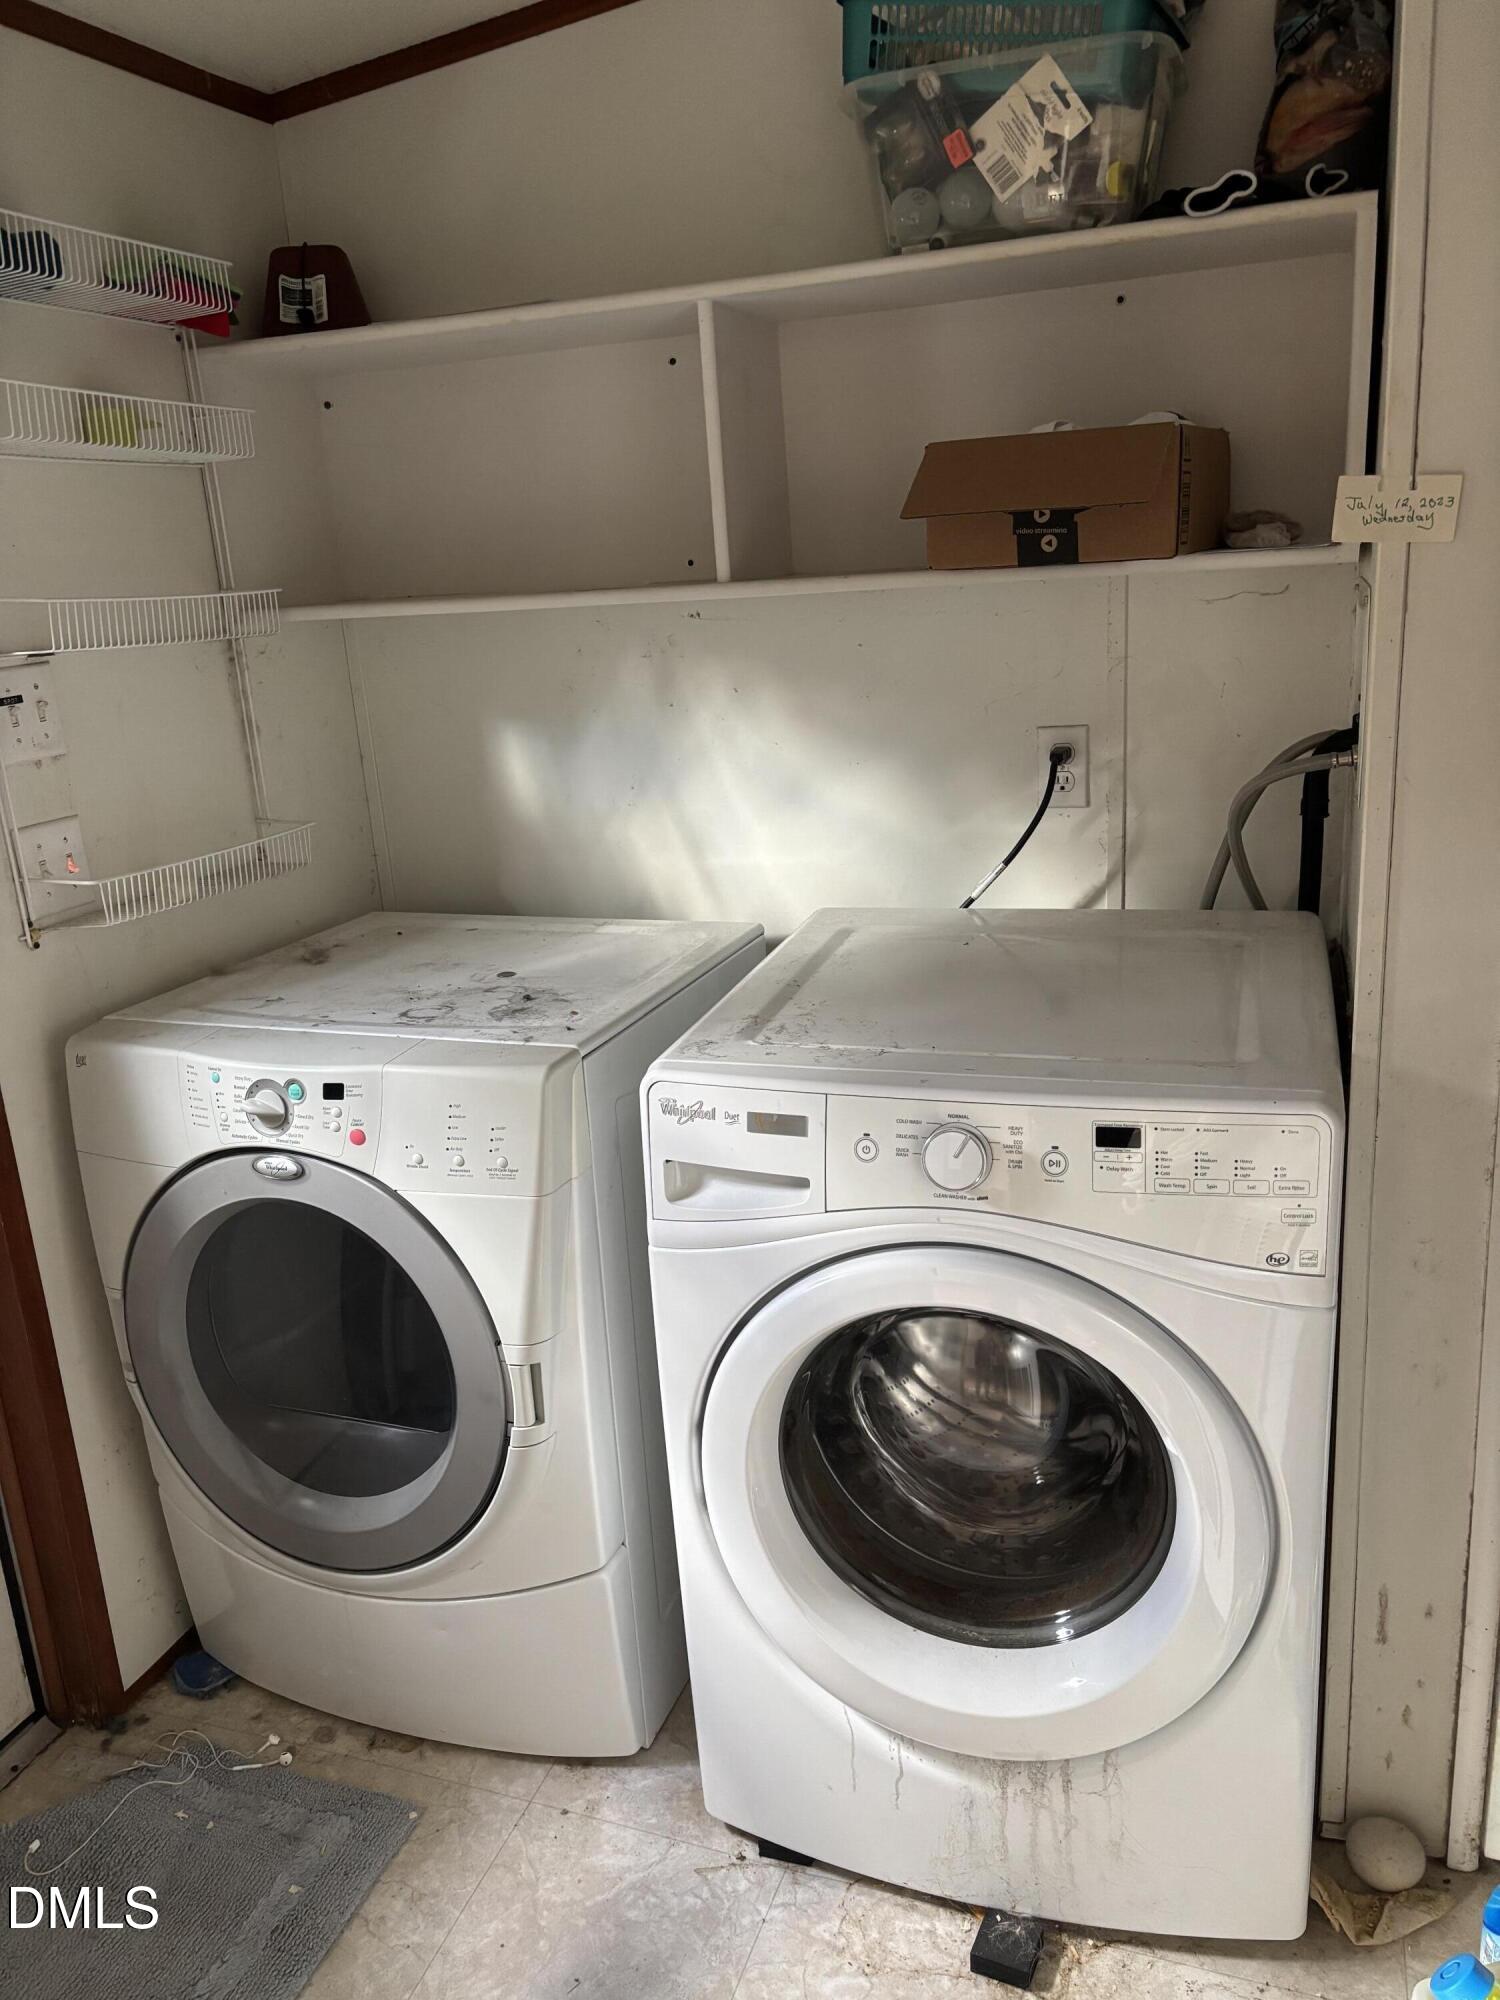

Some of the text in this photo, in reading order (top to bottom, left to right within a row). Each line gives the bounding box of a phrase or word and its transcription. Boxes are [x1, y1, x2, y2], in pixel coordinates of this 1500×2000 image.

[1345, 496, 1383, 516] July
[1419, 496, 1455, 508] 2023
[1362, 510, 1434, 529] Wednesday
[658, 1098, 716, 1125] Whirlpool
